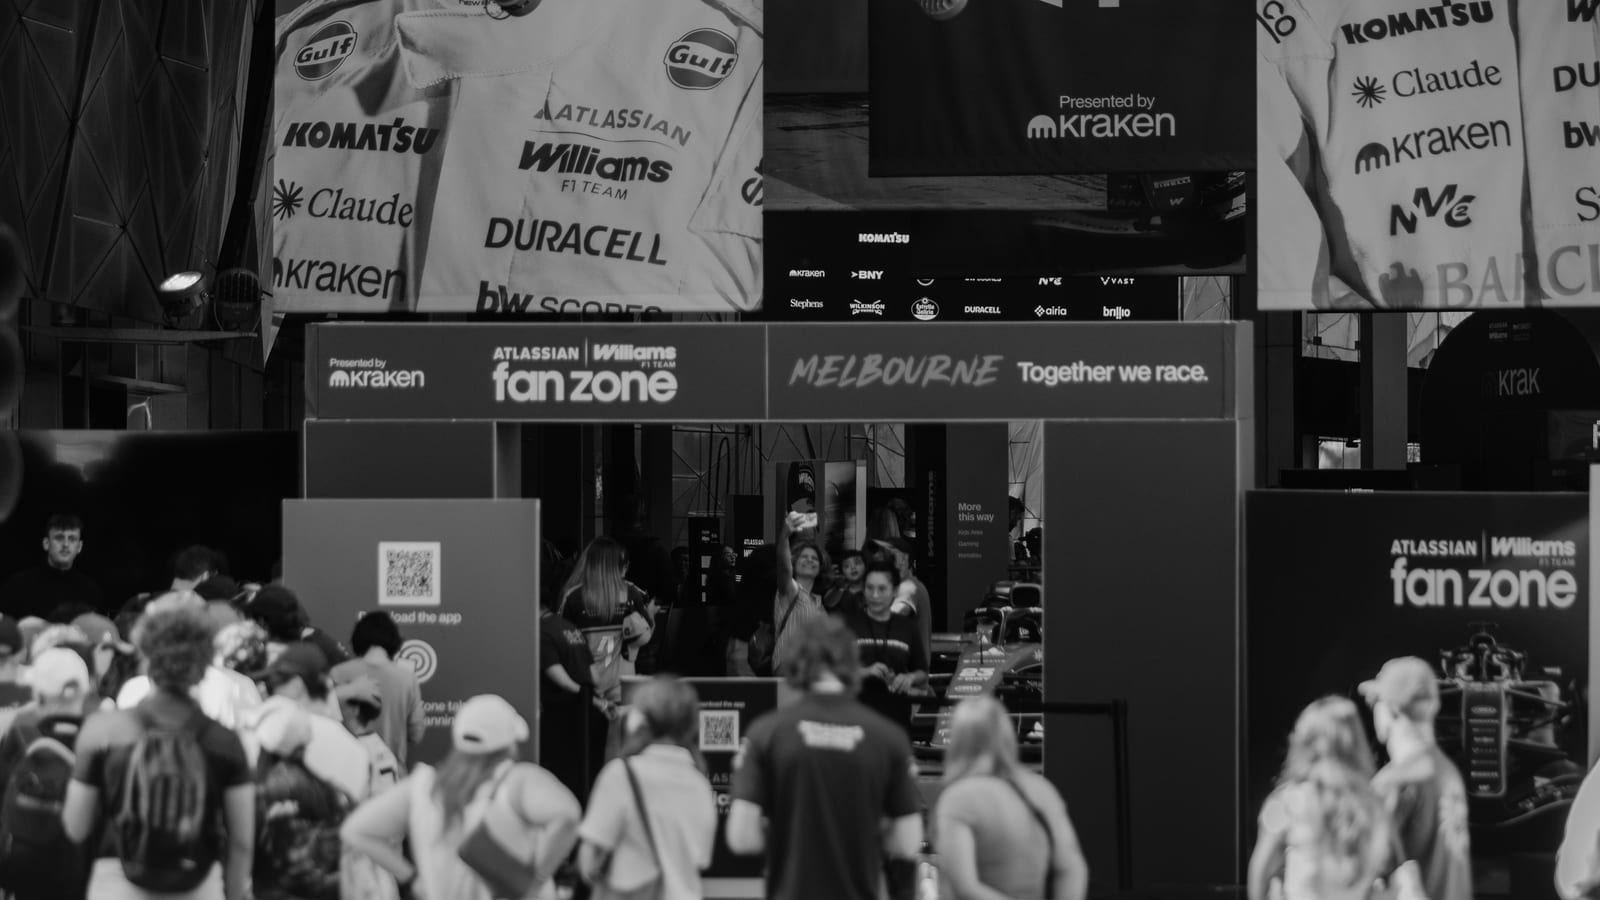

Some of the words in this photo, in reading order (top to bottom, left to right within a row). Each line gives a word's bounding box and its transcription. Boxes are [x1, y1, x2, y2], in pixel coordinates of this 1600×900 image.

[1341, 0, 1493, 44] KOMATSU
[296, 36, 354, 65] Gulf
[671, 44, 734, 78] Gulf
[1393, 60, 1502, 97] Claude
[1553, 61, 1600, 92] DU
[1060, 94, 1133, 108] Presented
[1137, 93, 1155, 110] by
[283, 117, 441, 155] KOMATSU
[555, 103, 692, 147] ATLASSIAN
[1060, 113, 1175, 137] kraken
[1393, 120, 1511, 163] kraken
[518, 140, 673, 183] Williams
[561, 180, 576, 192] F1
[583, 182, 628, 200] TEAM
[308, 188, 413, 228] Claude
[1576, 187, 1600, 222] S
[484, 217, 666, 265] DURACELL
[859, 232, 909, 243] KOMATSU
[285, 257, 406, 301] kraken
[798, 270, 825, 278] kraken
[859, 271, 883, 279] BNY
[790, 299, 823, 309] Stephens
[1046, 306, 1066, 315] airia
[330, 358, 372, 367] Presented
[374, 358, 387, 369] by
[493, 347, 579, 360] ATLASSIAN
[594, 345, 676, 360] Williams
[350, 368, 424, 387] kraken
[493, 362, 564, 402] fan
[570, 370, 677, 402] zone
[789, 354, 1003, 387] MELBOURNE
[1017, 361, 1115, 386] Together
[1118, 365, 1151, 382] we
[1156, 365, 1208, 382] race.
[1499, 368, 1540, 395] krak
[959, 503, 981, 511] More
[959, 512, 974, 521] this
[976, 514, 994, 522] way
[1391, 540, 1477, 556] ATLASSIAN
[1492, 538, 1575, 556] Williams
[1391, 557, 1463, 606] fan
[1469, 570, 1577, 608] zone
[418, 612, 437, 623] the
[439, 612, 463, 624] app
